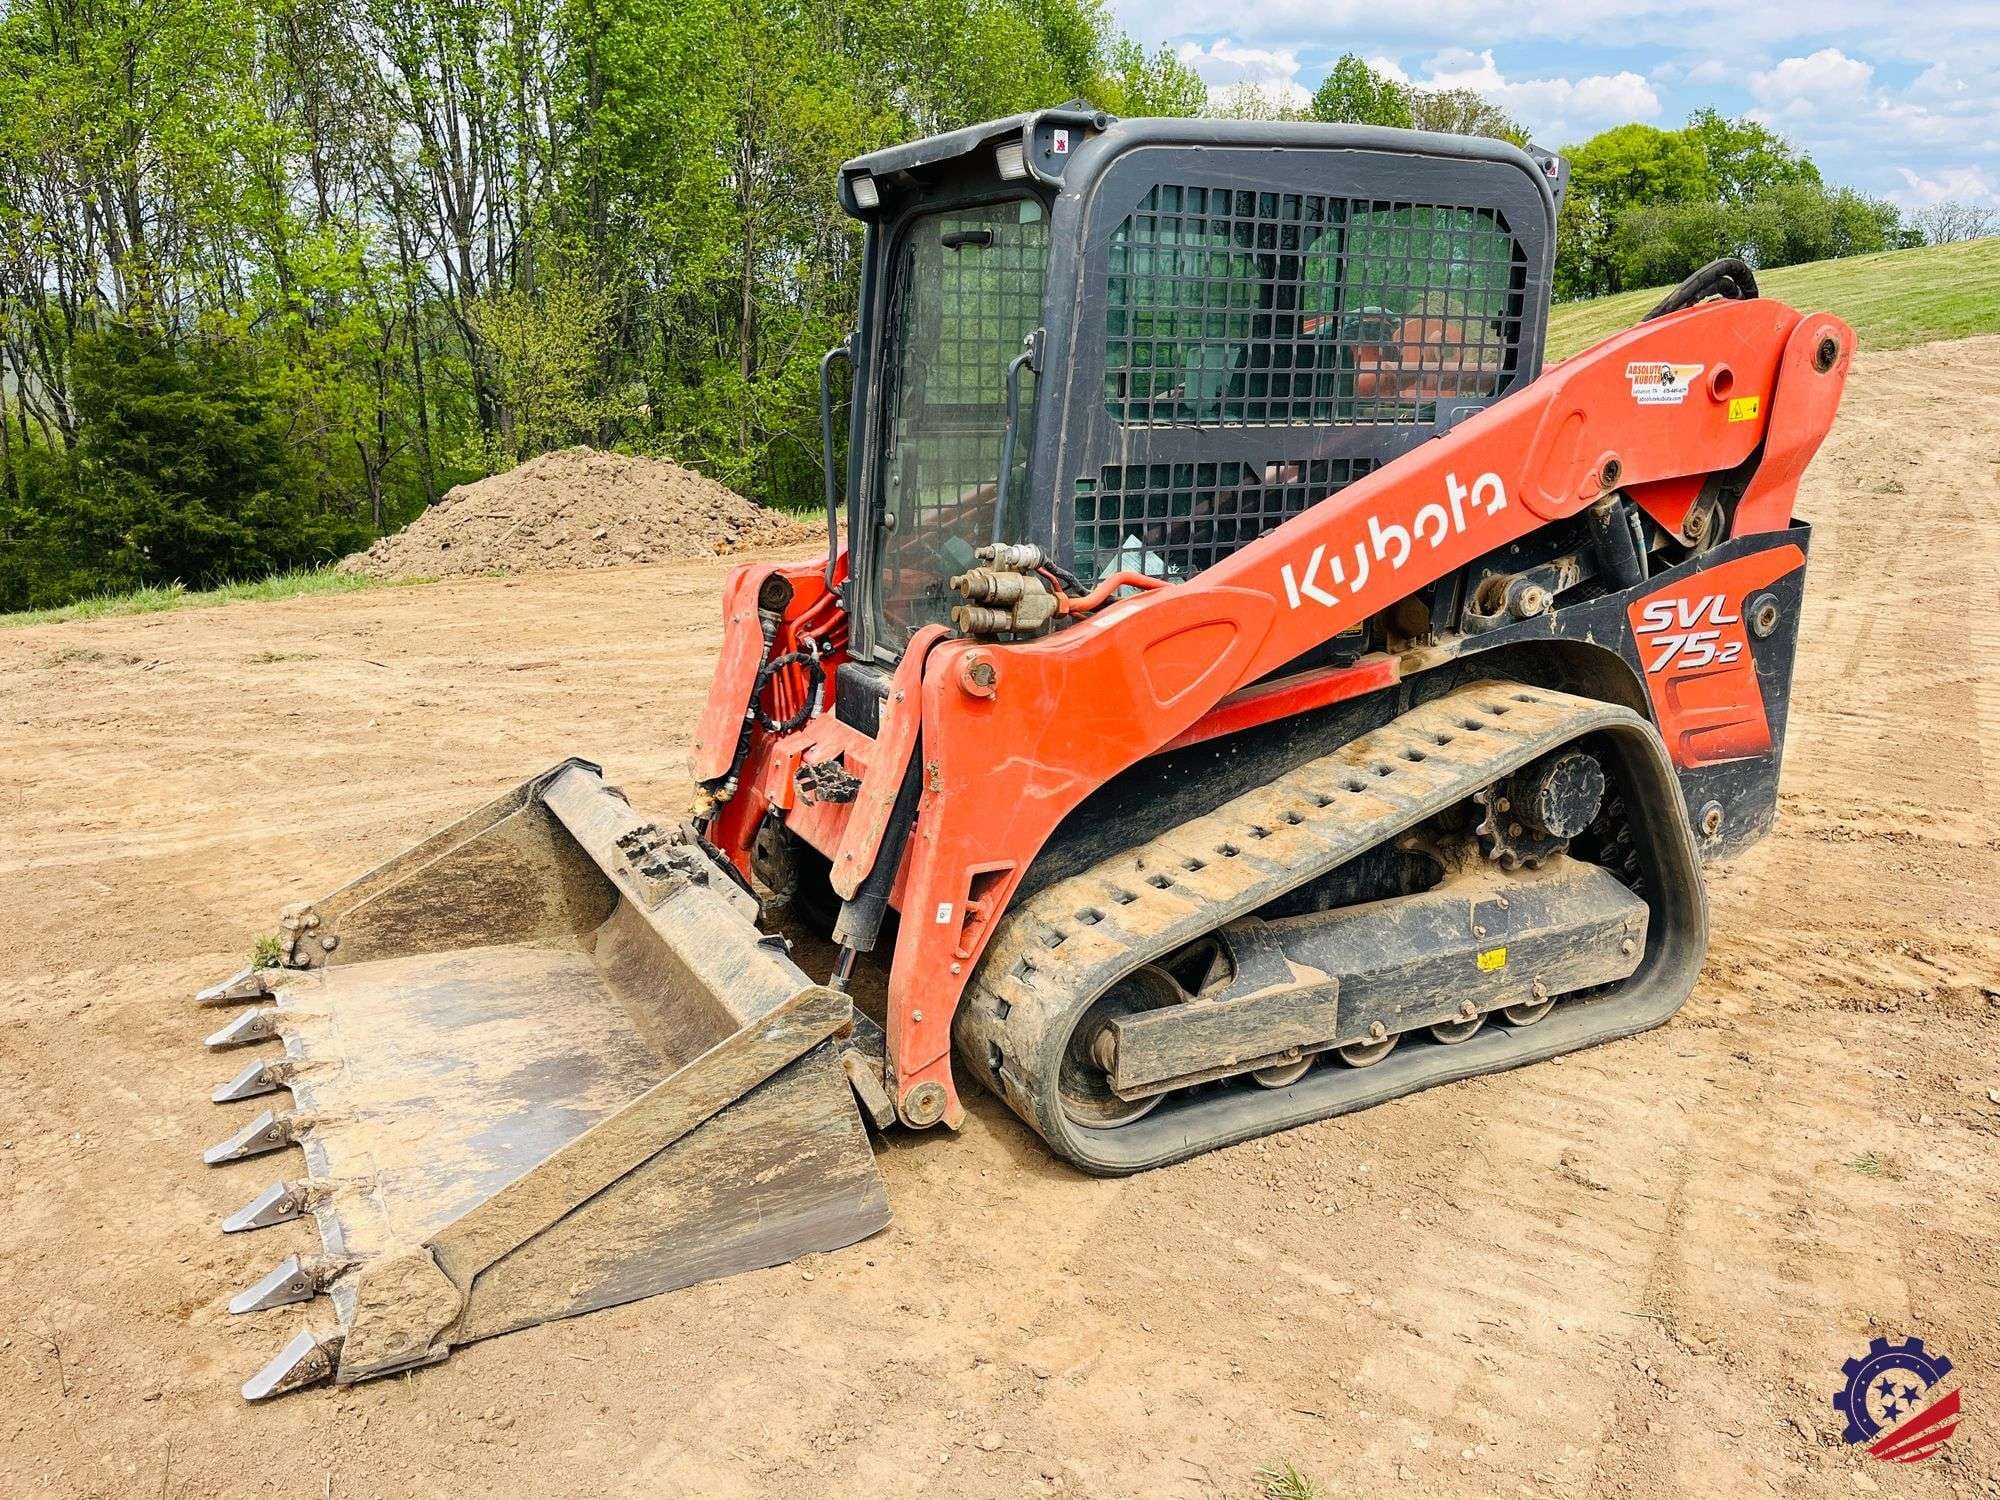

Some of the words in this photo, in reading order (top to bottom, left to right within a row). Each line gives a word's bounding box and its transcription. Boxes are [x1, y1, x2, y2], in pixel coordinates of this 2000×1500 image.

[1628, 365, 1663, 375] ABSOLUTE
[1634, 374, 1663, 384] KUBOTA
[1280, 472, 1508, 609] Kubota
[1636, 594, 1739, 634] SVL
[1647, 629, 1743, 674] 75-2
